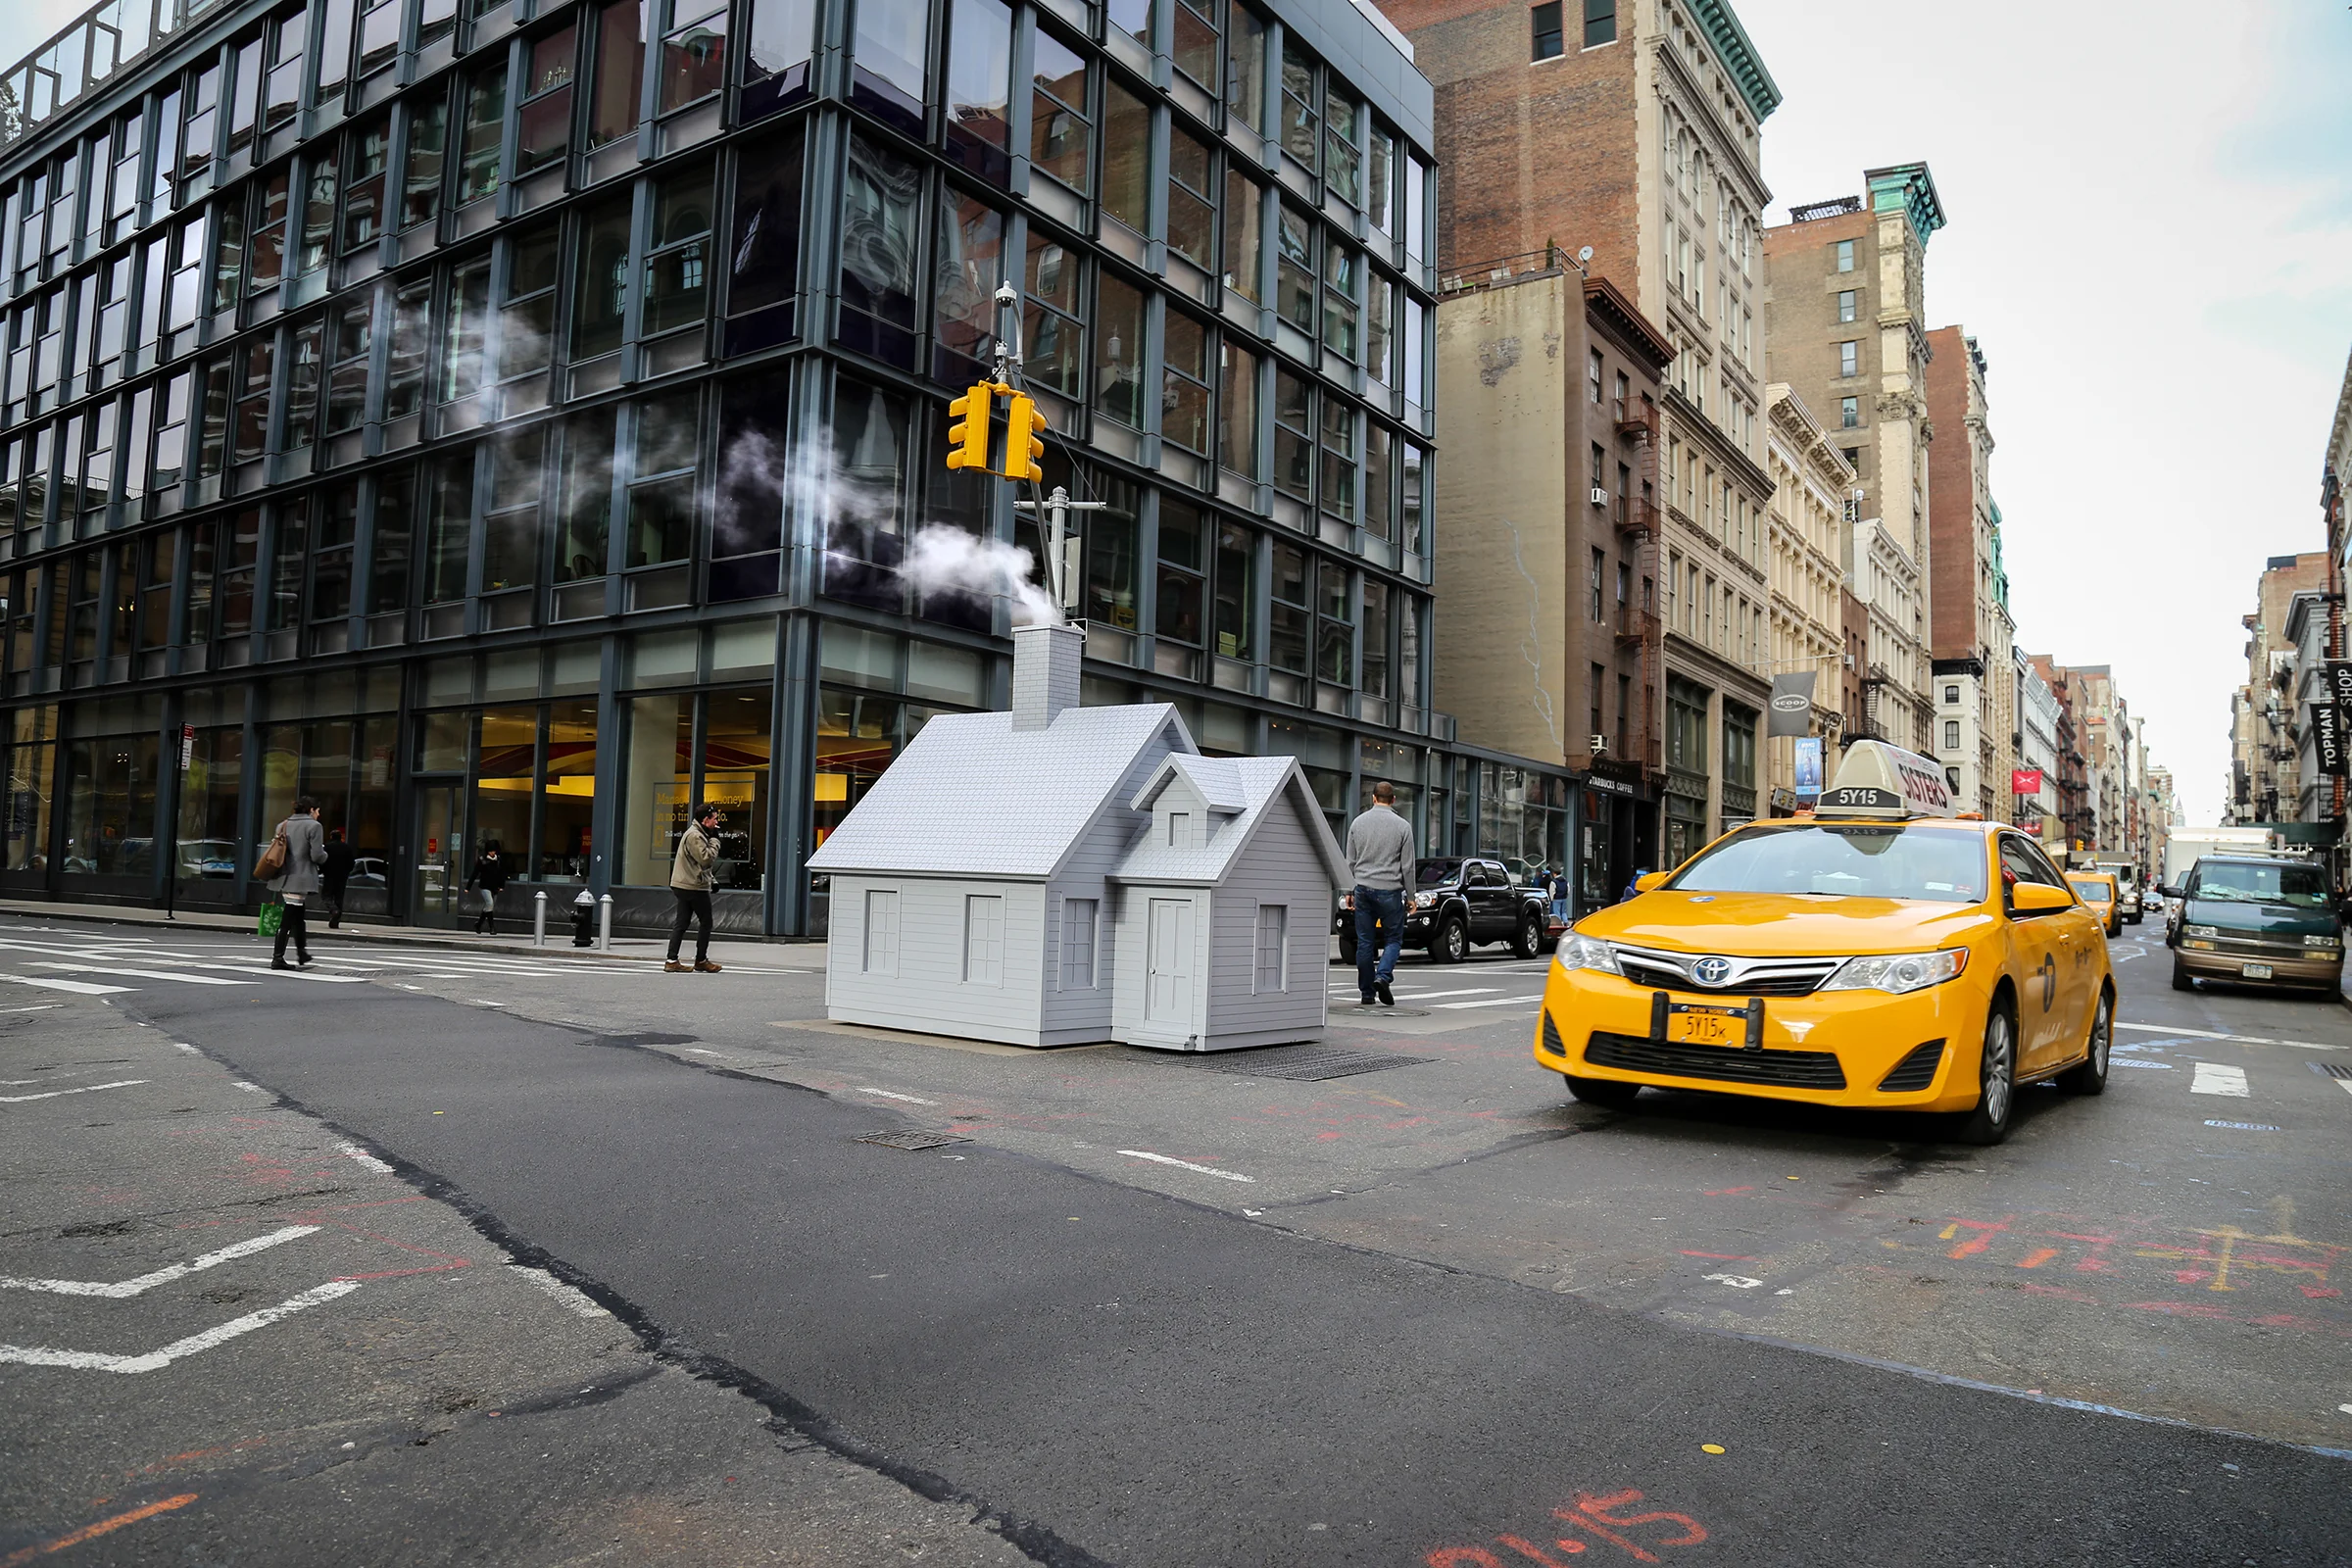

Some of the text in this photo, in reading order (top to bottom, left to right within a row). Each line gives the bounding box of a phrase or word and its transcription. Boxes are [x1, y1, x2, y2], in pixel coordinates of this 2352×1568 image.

[2319, 709, 2337, 767] TOPMAN
[1616, 782, 1634, 794] COFFEE
[1838, 789, 1878, 805] 5Y15
[1897, 763, 1948, 809] SISTERS
